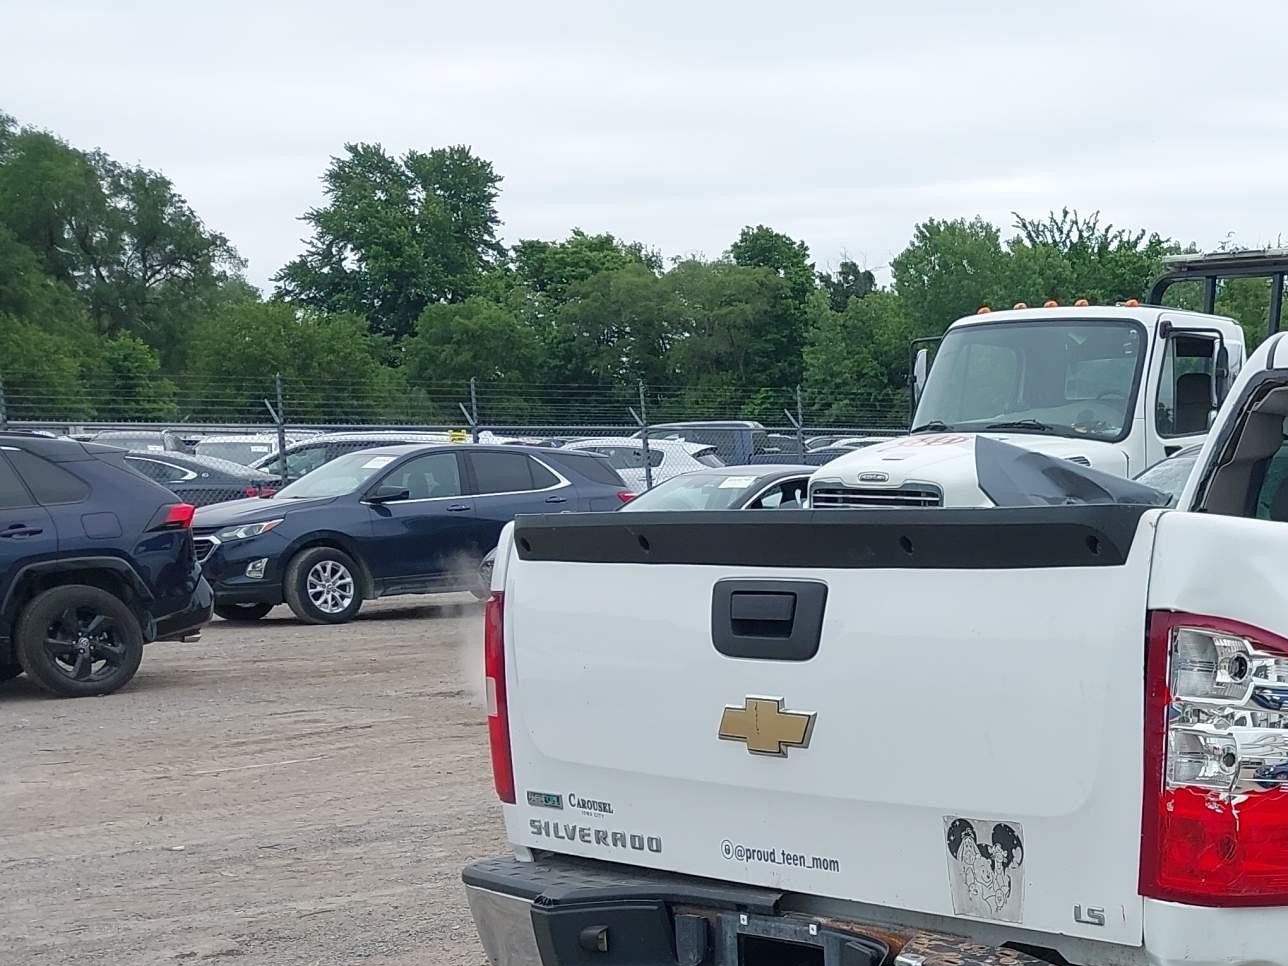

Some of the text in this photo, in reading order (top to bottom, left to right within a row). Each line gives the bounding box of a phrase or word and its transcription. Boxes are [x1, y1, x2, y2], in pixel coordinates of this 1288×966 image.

[568, 793, 614, 814] CAROUSEL
[529, 818, 662, 854] SILVERADO
[734, 845, 840, 873] @proud_teen_mom
[1073, 903, 1106, 927] LS
